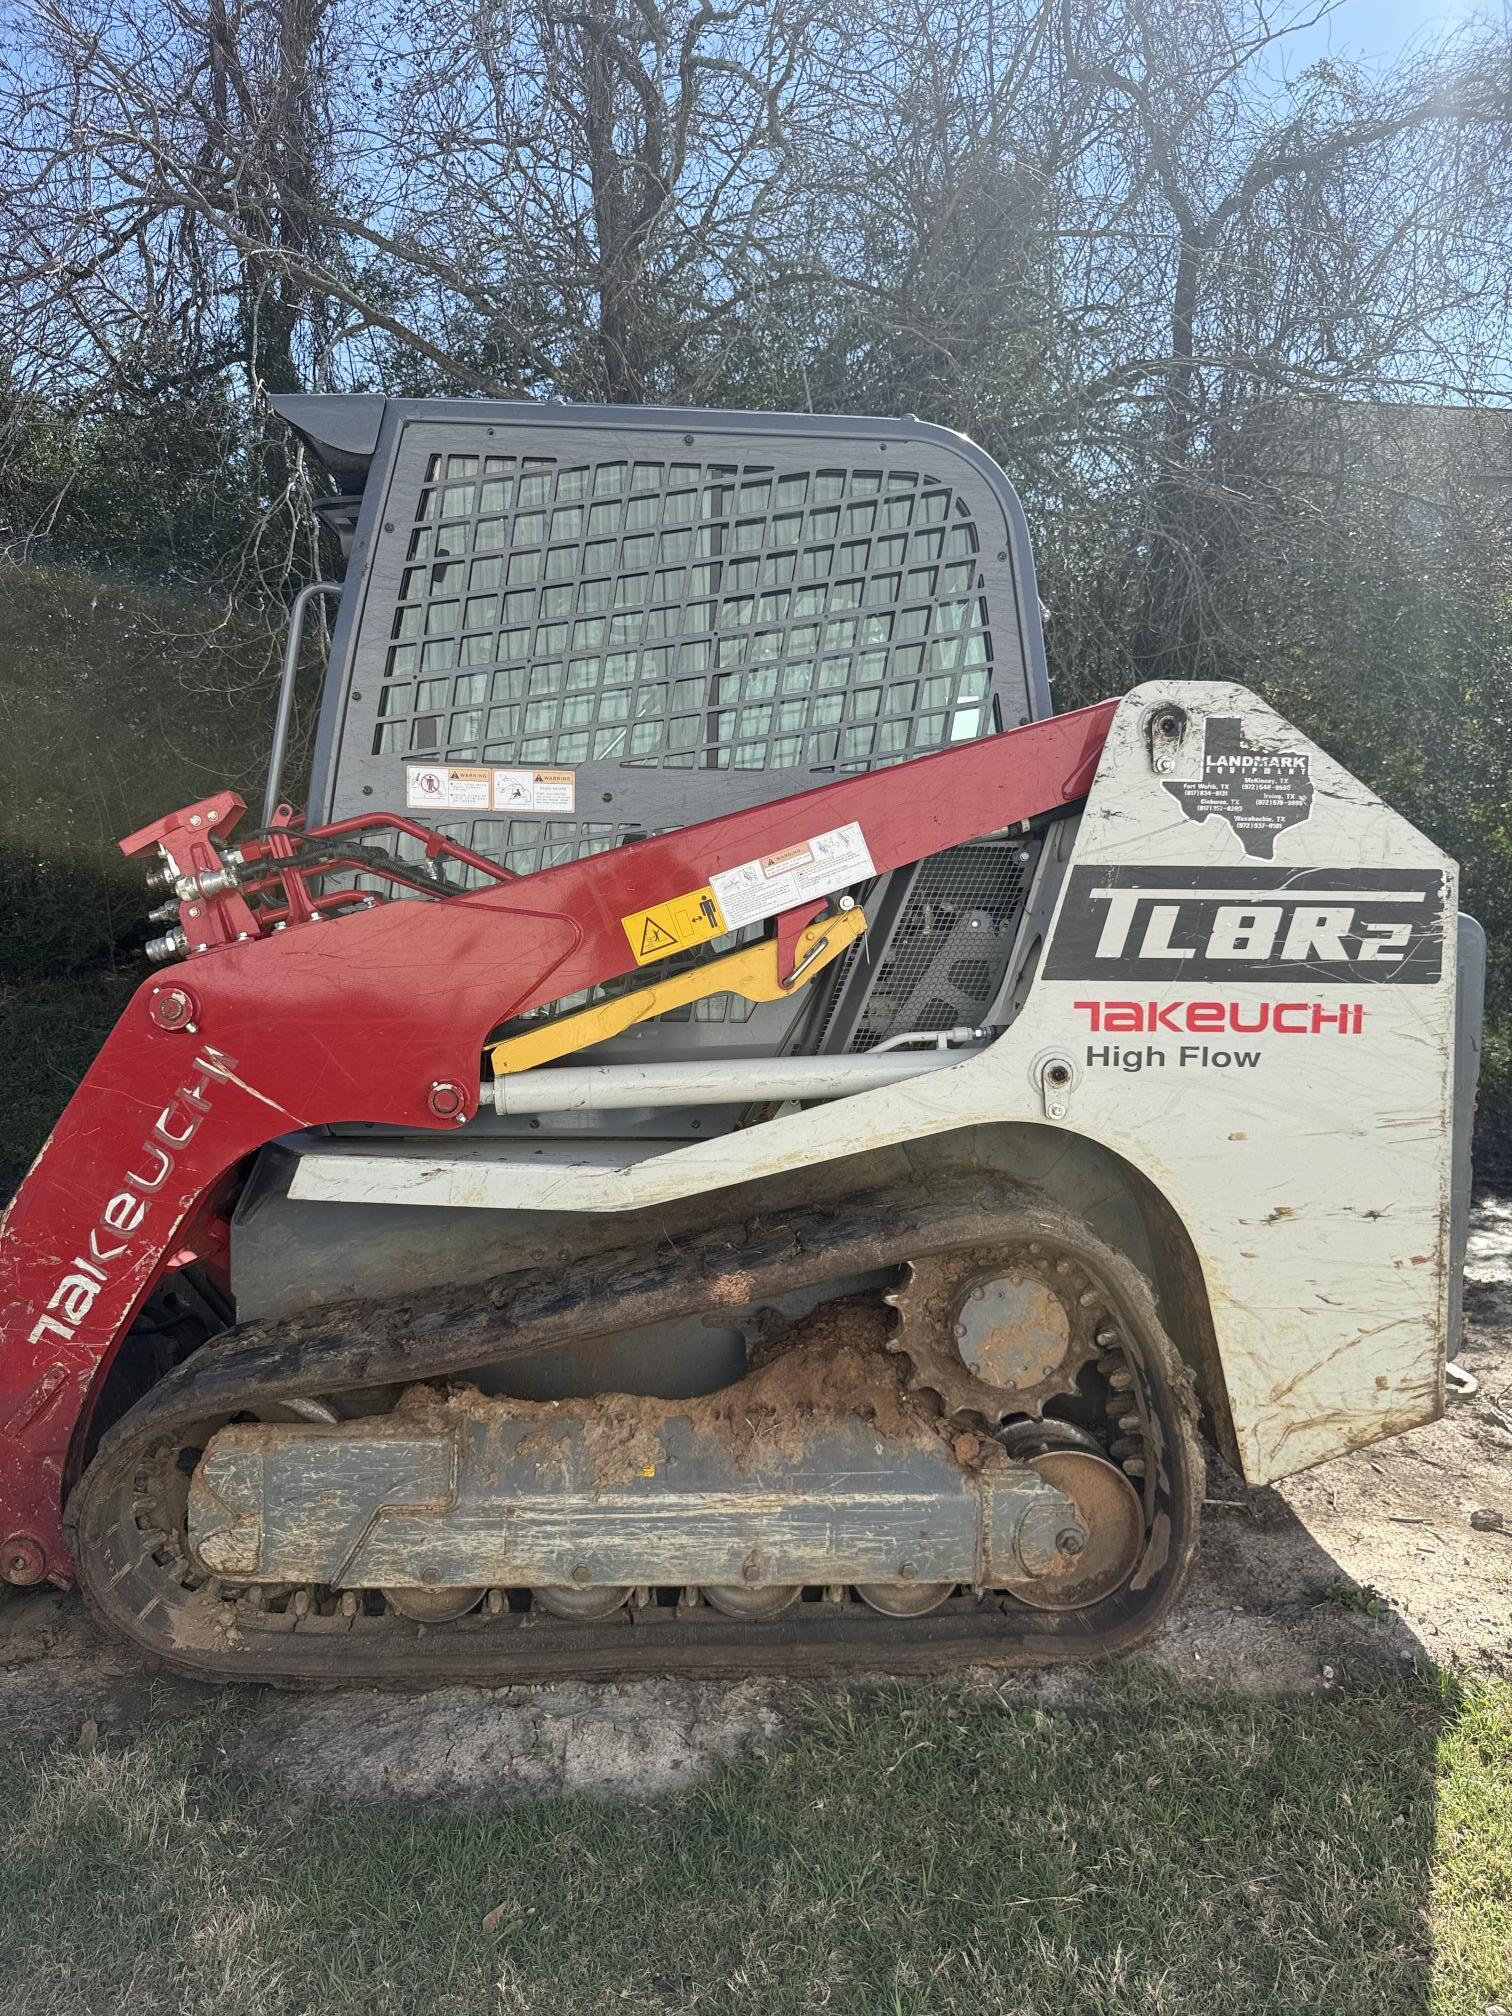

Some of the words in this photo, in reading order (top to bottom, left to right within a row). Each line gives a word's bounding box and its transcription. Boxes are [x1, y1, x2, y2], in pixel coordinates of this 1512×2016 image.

[1206, 755, 1306, 767] LANDMARK
[1086, 1045, 1165, 1072] High
[1179, 1046, 1261, 1067] Flow
